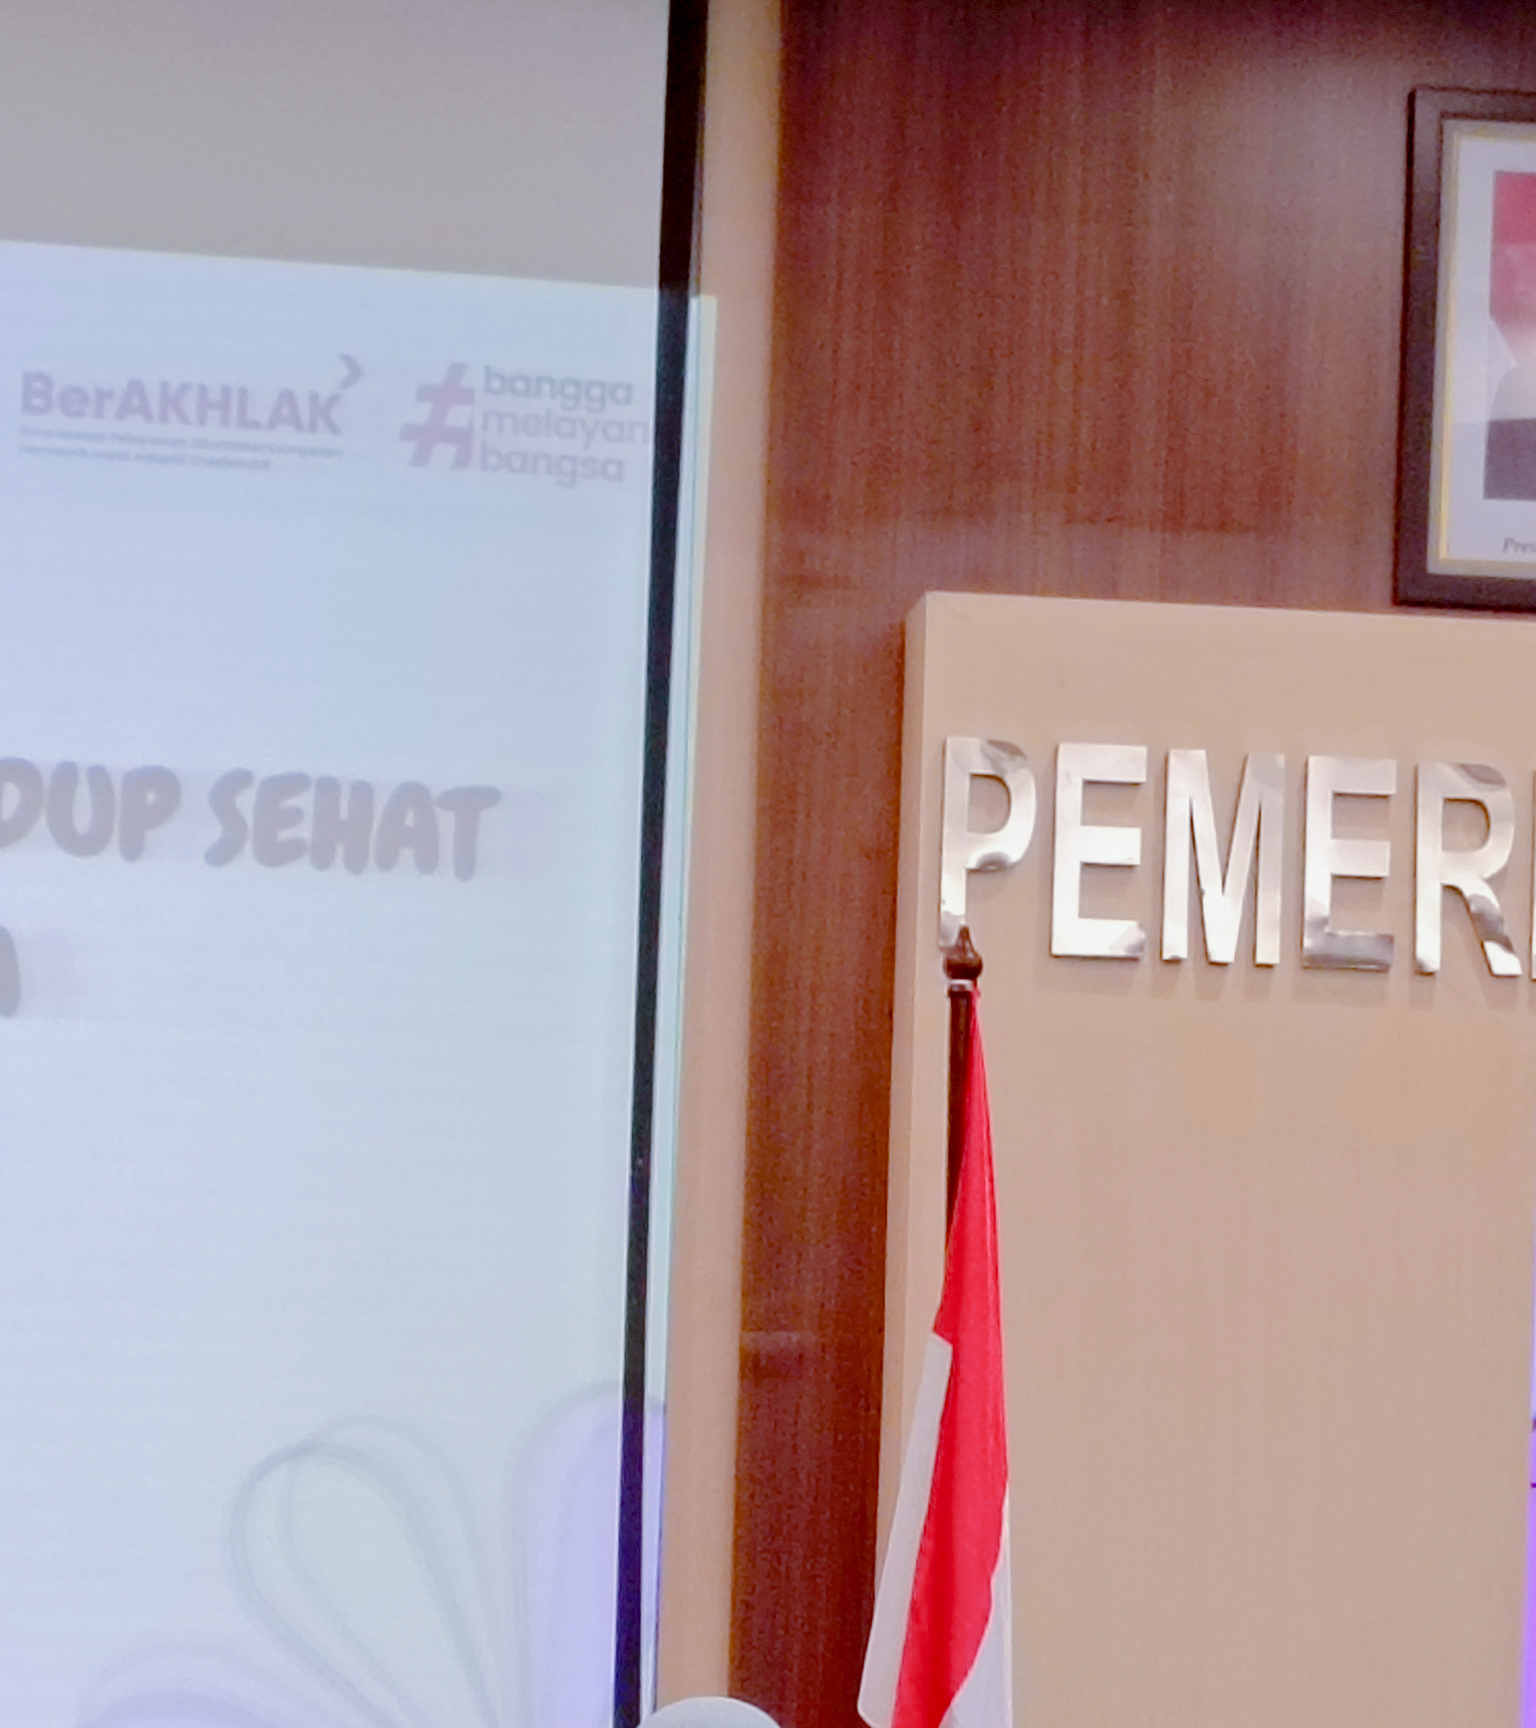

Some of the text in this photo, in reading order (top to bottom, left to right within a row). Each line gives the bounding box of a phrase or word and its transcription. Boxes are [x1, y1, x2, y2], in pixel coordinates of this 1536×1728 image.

[21, 370, 342, 436] BerAKHLAK
[483, 366, 632, 413] bangga
[480, 443, 624, 488] bangsa
[203, 766, 503, 884] SEHAT
